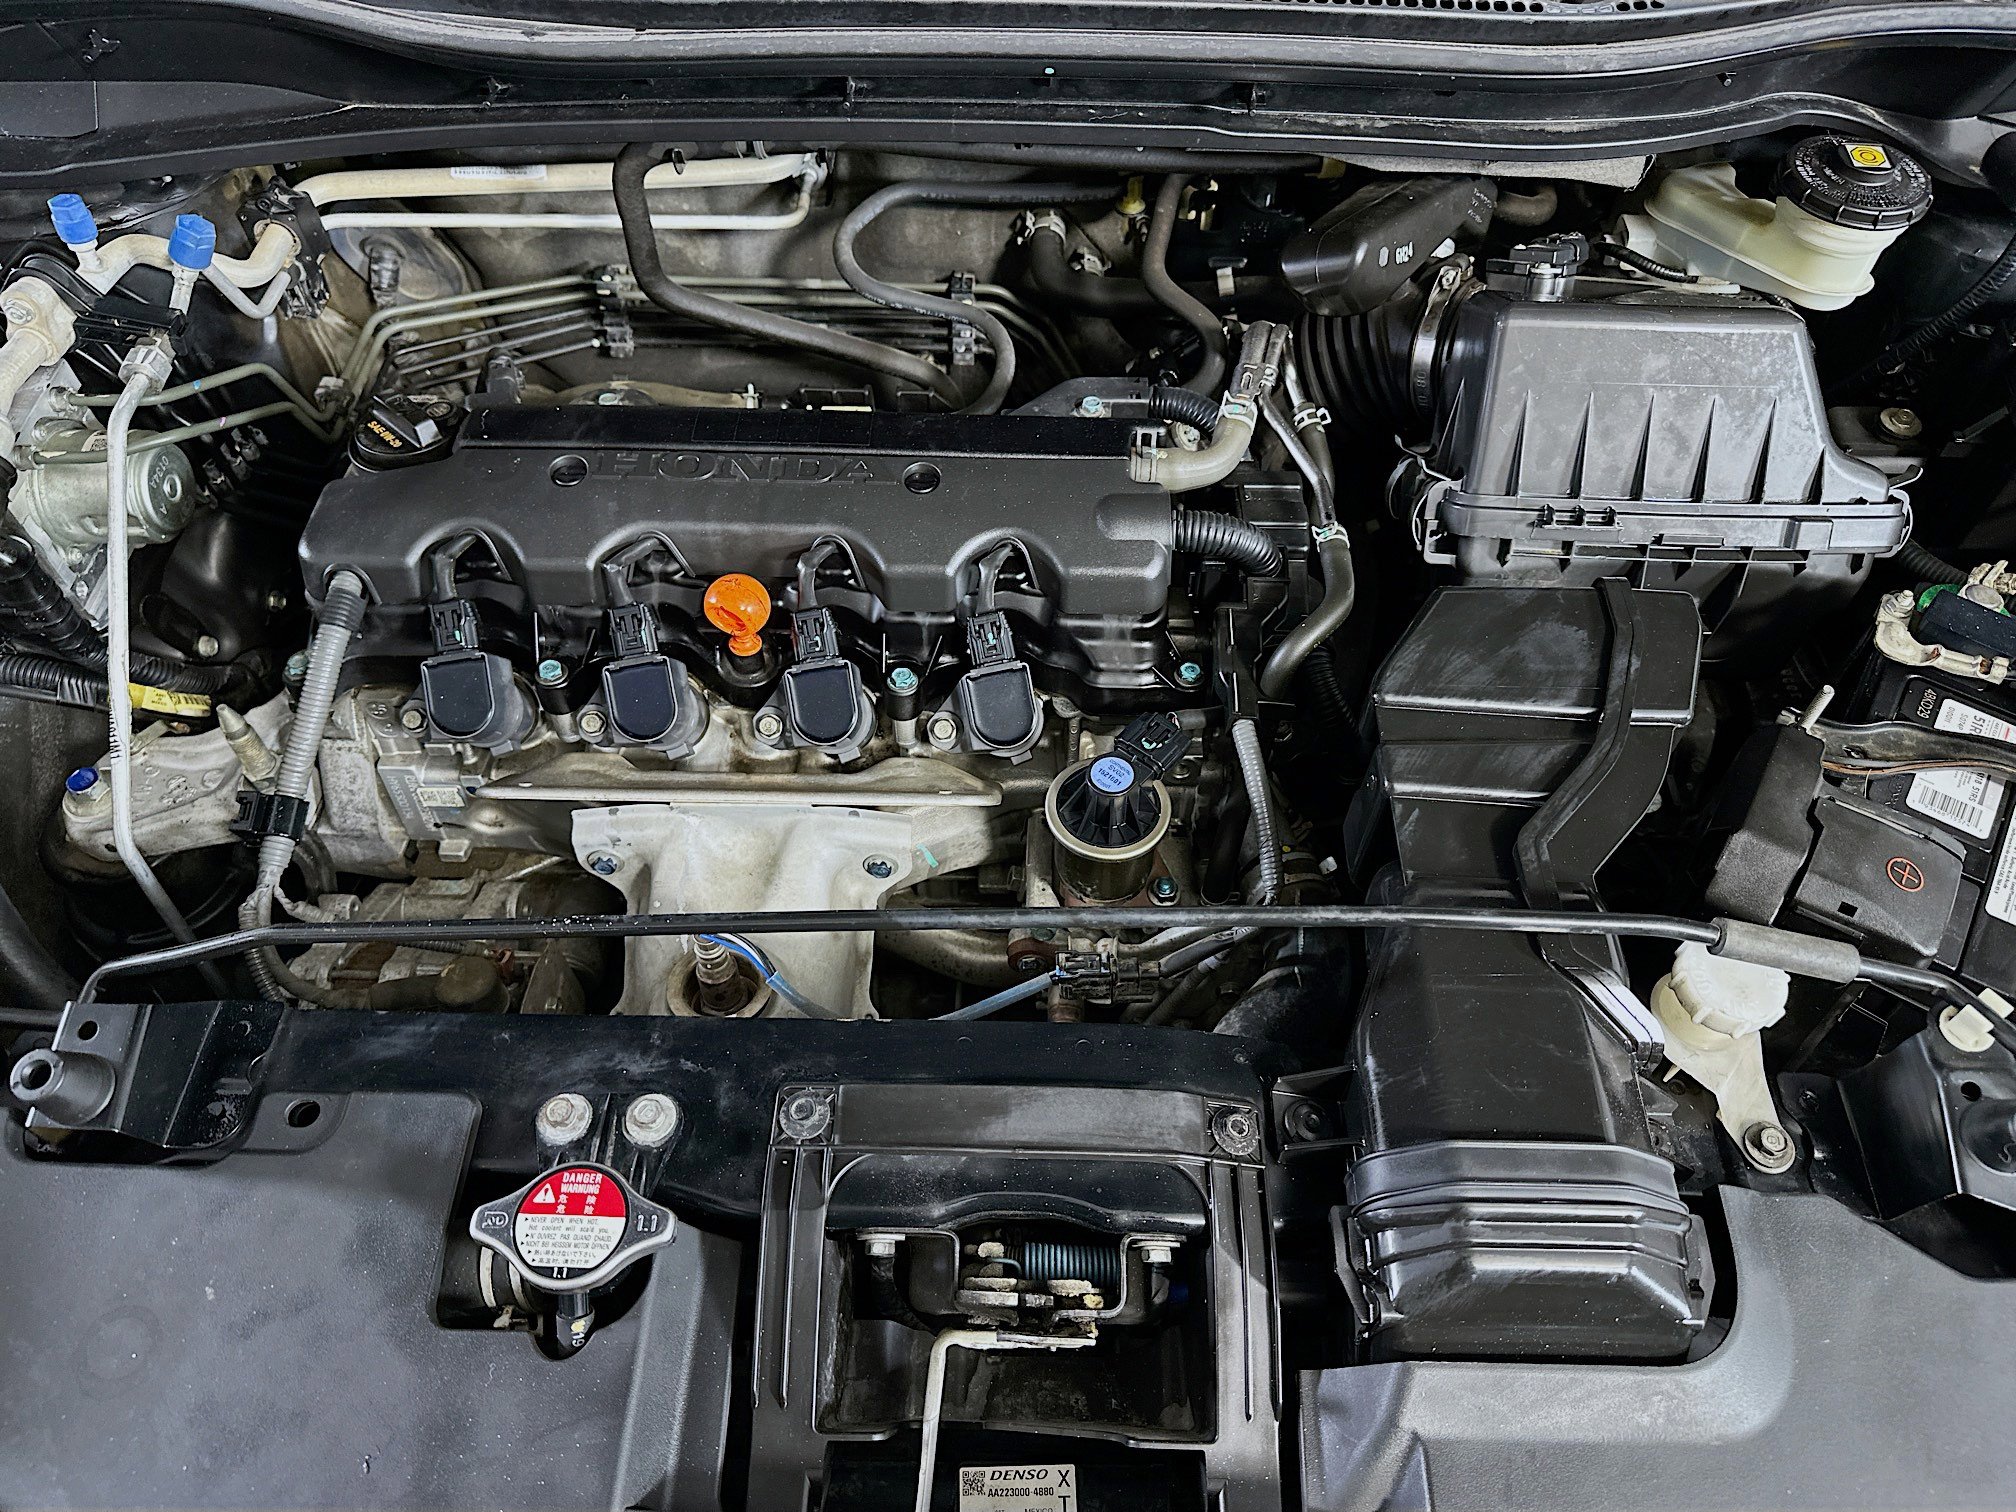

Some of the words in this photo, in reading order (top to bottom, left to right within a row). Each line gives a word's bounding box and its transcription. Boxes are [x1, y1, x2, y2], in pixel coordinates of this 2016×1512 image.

[367, 420, 386, 435] SAE
[590, 451, 898, 486] HONDA
[1968, 714, 1987, 737] 51R
[562, 1171, 603, 1184] DANGER
[560, 1183, 601, 1195] WARNUNG
[530, 1216, 546, 1224] NEVER
[550, 1216, 564, 1224] OPEN
[568, 1217, 583, 1225] WHEN
[636, 1214, 660, 1233] 1.1
[552, 1266, 568, 1279] 1.1
[989, 1468, 1049, 1481] DENSO
[1057, 1469, 1071, 1488] X
